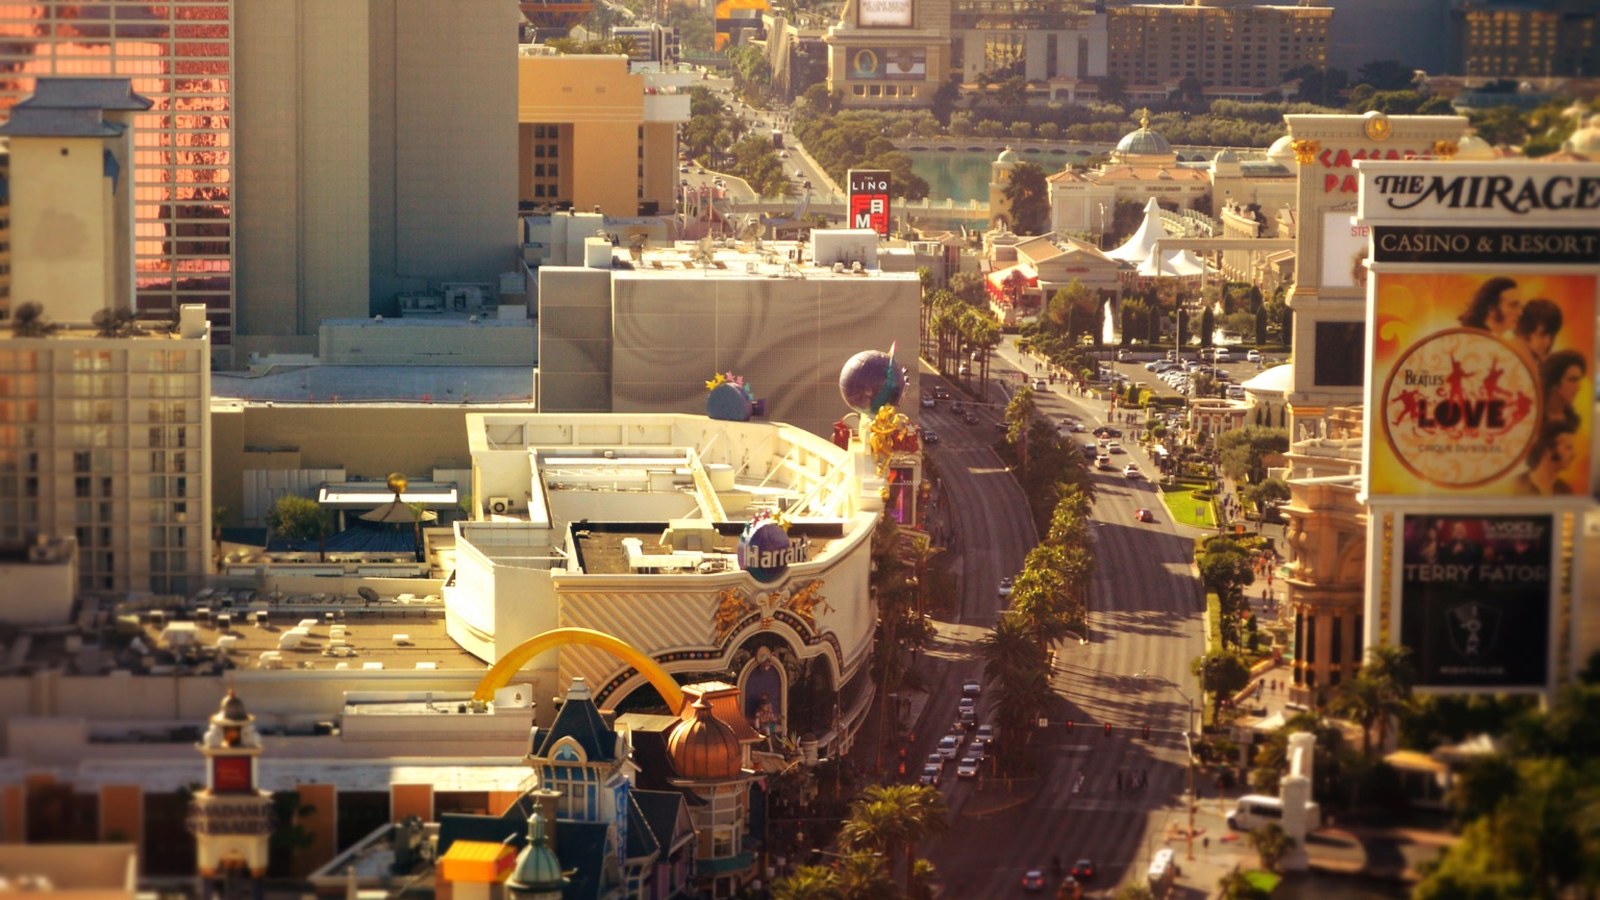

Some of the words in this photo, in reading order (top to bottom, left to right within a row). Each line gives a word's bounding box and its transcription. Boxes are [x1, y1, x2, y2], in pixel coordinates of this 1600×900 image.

[852, 181, 888, 190] LINQ
[1374, 175, 1425, 194] THE
[1388, 174, 1600, 215] MIRAGE
[1380, 234, 1470, 253] CASINO
[1478, 235, 1494, 252] &
[1501, 235, 1597, 254] RESORT
[1405, 369, 1444, 387] BEATLES
[1417, 399, 1506, 429] LOVE
[1404, 564, 1473, 581] TERRY
